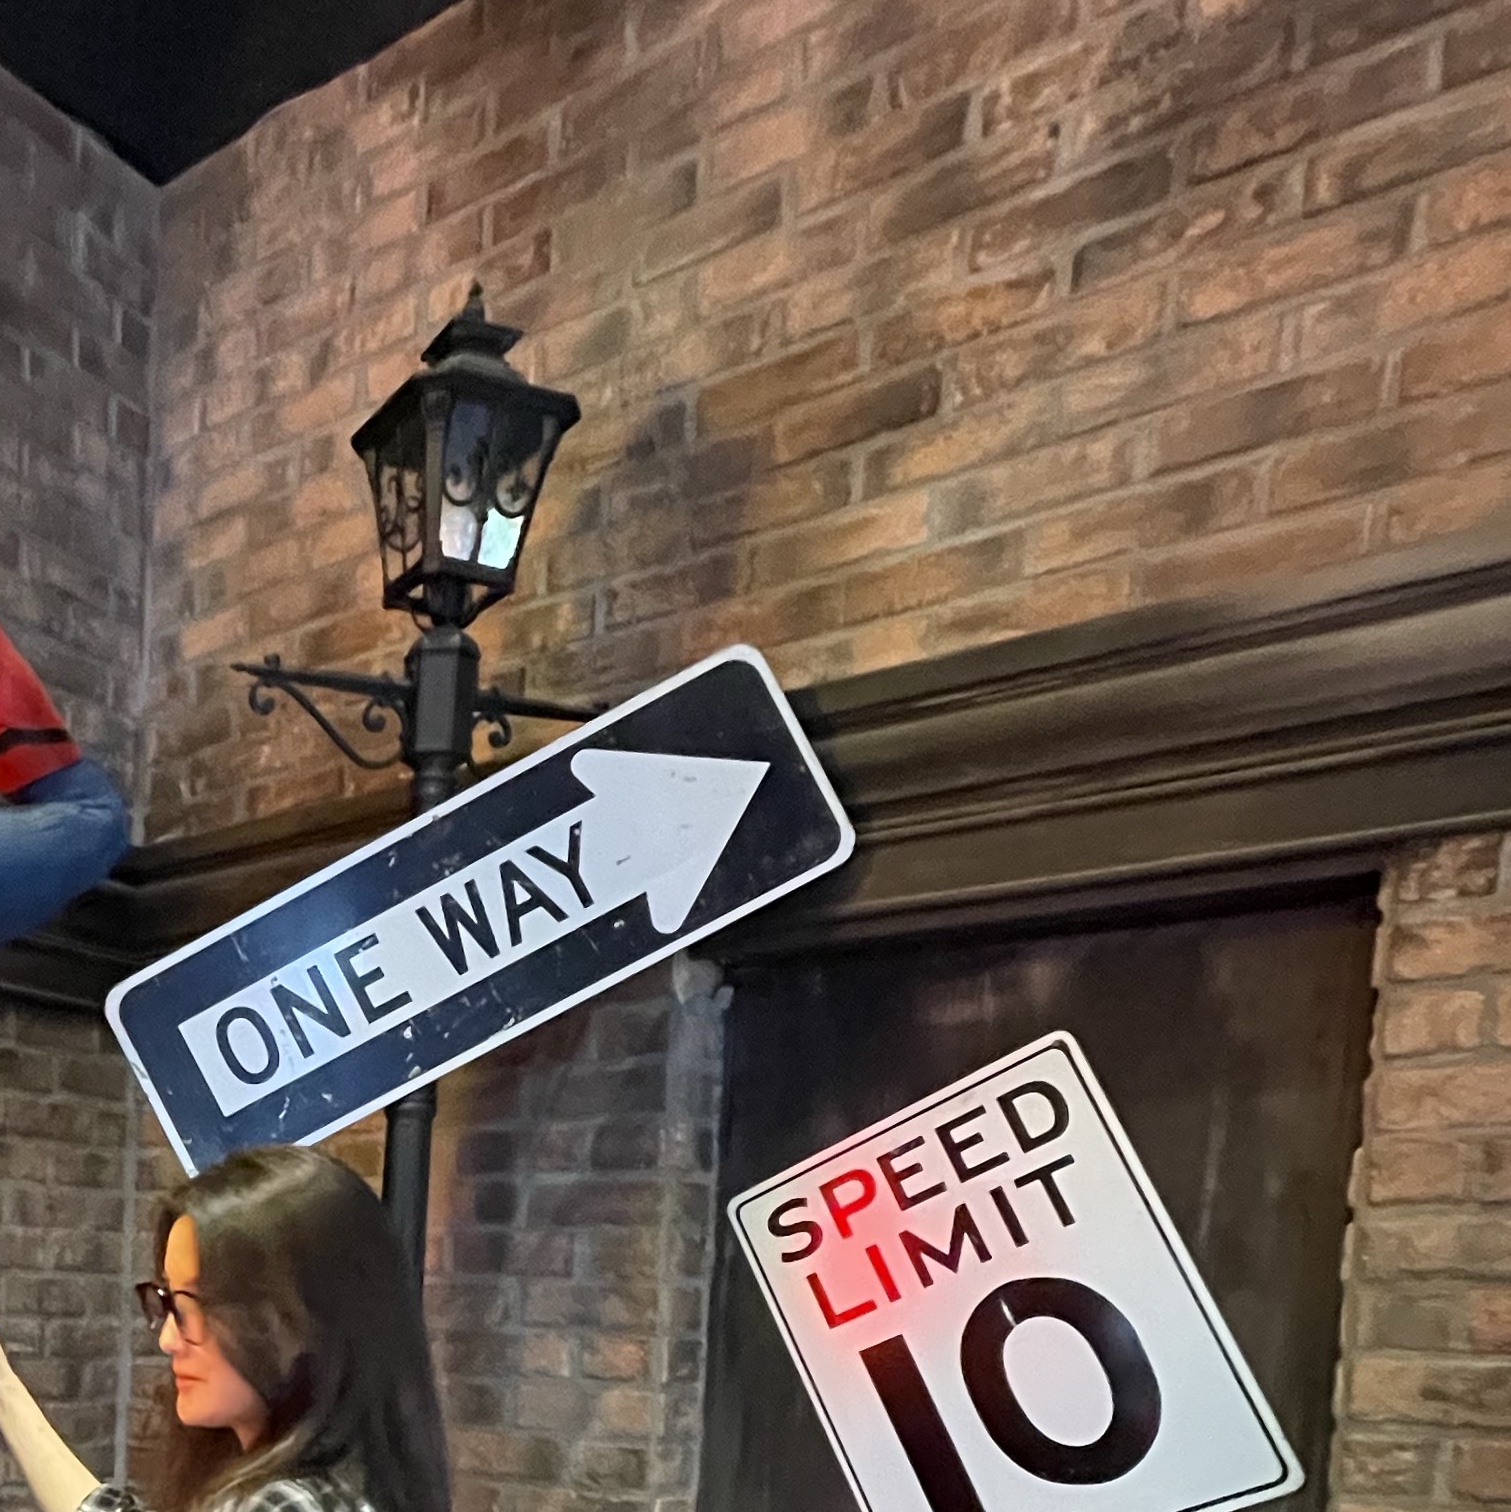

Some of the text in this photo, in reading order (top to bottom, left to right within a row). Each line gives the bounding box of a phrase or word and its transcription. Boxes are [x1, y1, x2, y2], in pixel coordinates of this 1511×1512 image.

[215, 820, 594, 1084] ONE WAY
[767, 1080, 1070, 1263] SPEED
[806, 1154, 1076, 1328] LIMIT
